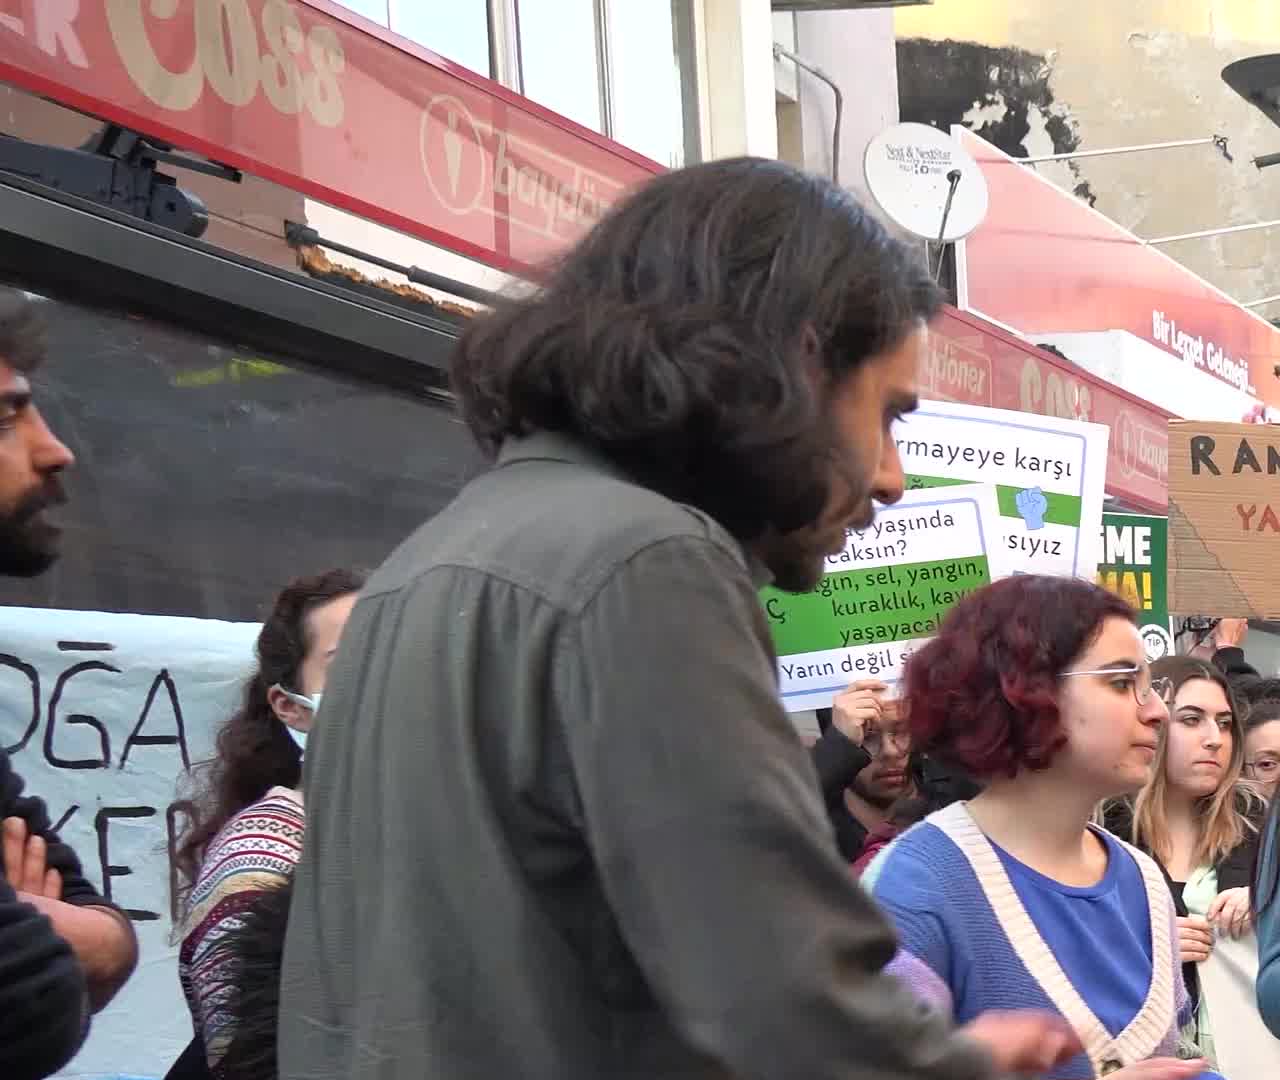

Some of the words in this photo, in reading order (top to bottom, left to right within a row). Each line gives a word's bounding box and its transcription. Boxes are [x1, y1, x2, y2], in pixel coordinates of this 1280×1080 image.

[896, 438, 1005, 469] rmayeye
[1014, 446, 1073, 480] karşı
[872, 509, 955, 540] yaşında
[827, 539, 908, 565] caksın?
[1006, 534, 1062, 557] sıyız
[865, 566, 901, 587] sel,
[906, 561, 985, 586] yangın,
[831, 589, 925, 617] kuraklık,
[781, 661, 834, 681] Yarın
[841, 651, 894, 676] değil
